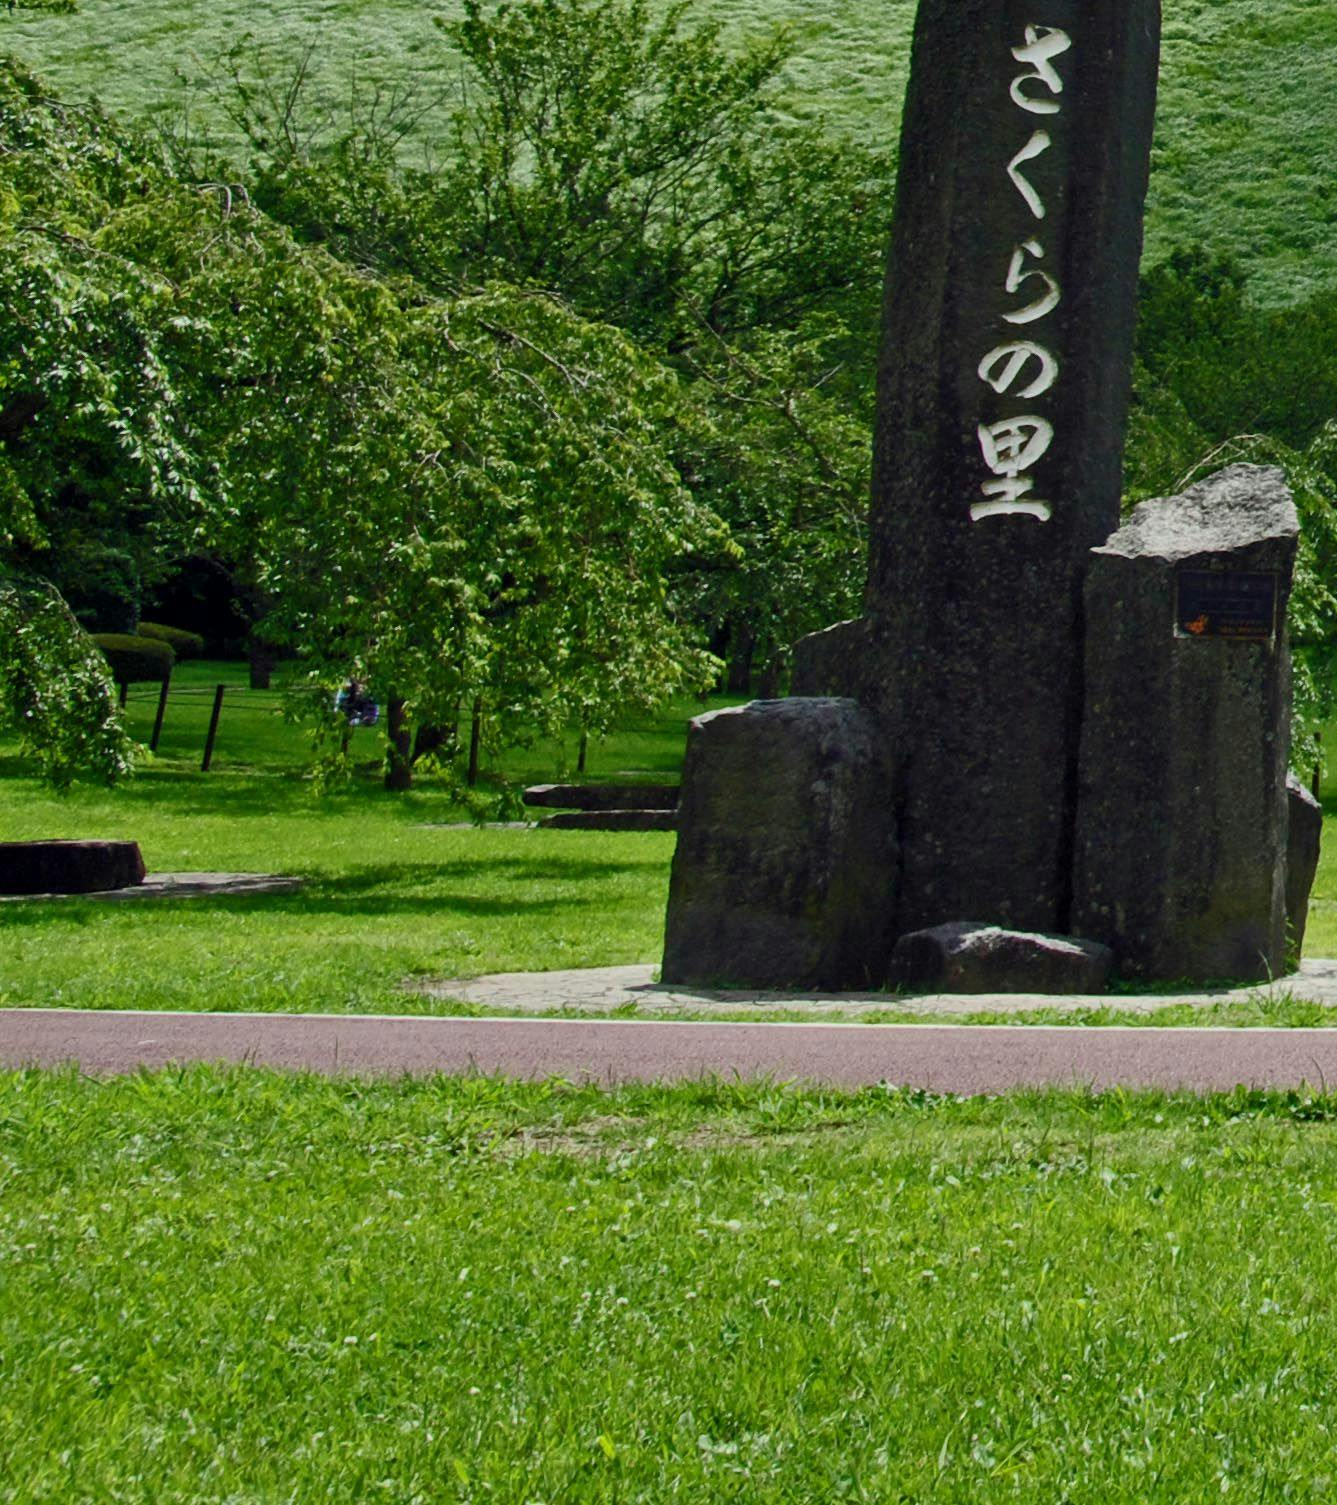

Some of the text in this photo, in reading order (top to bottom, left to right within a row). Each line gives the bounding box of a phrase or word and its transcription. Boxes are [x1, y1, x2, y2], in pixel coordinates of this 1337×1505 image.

[970, 24, 1072, 522] さくらの里
